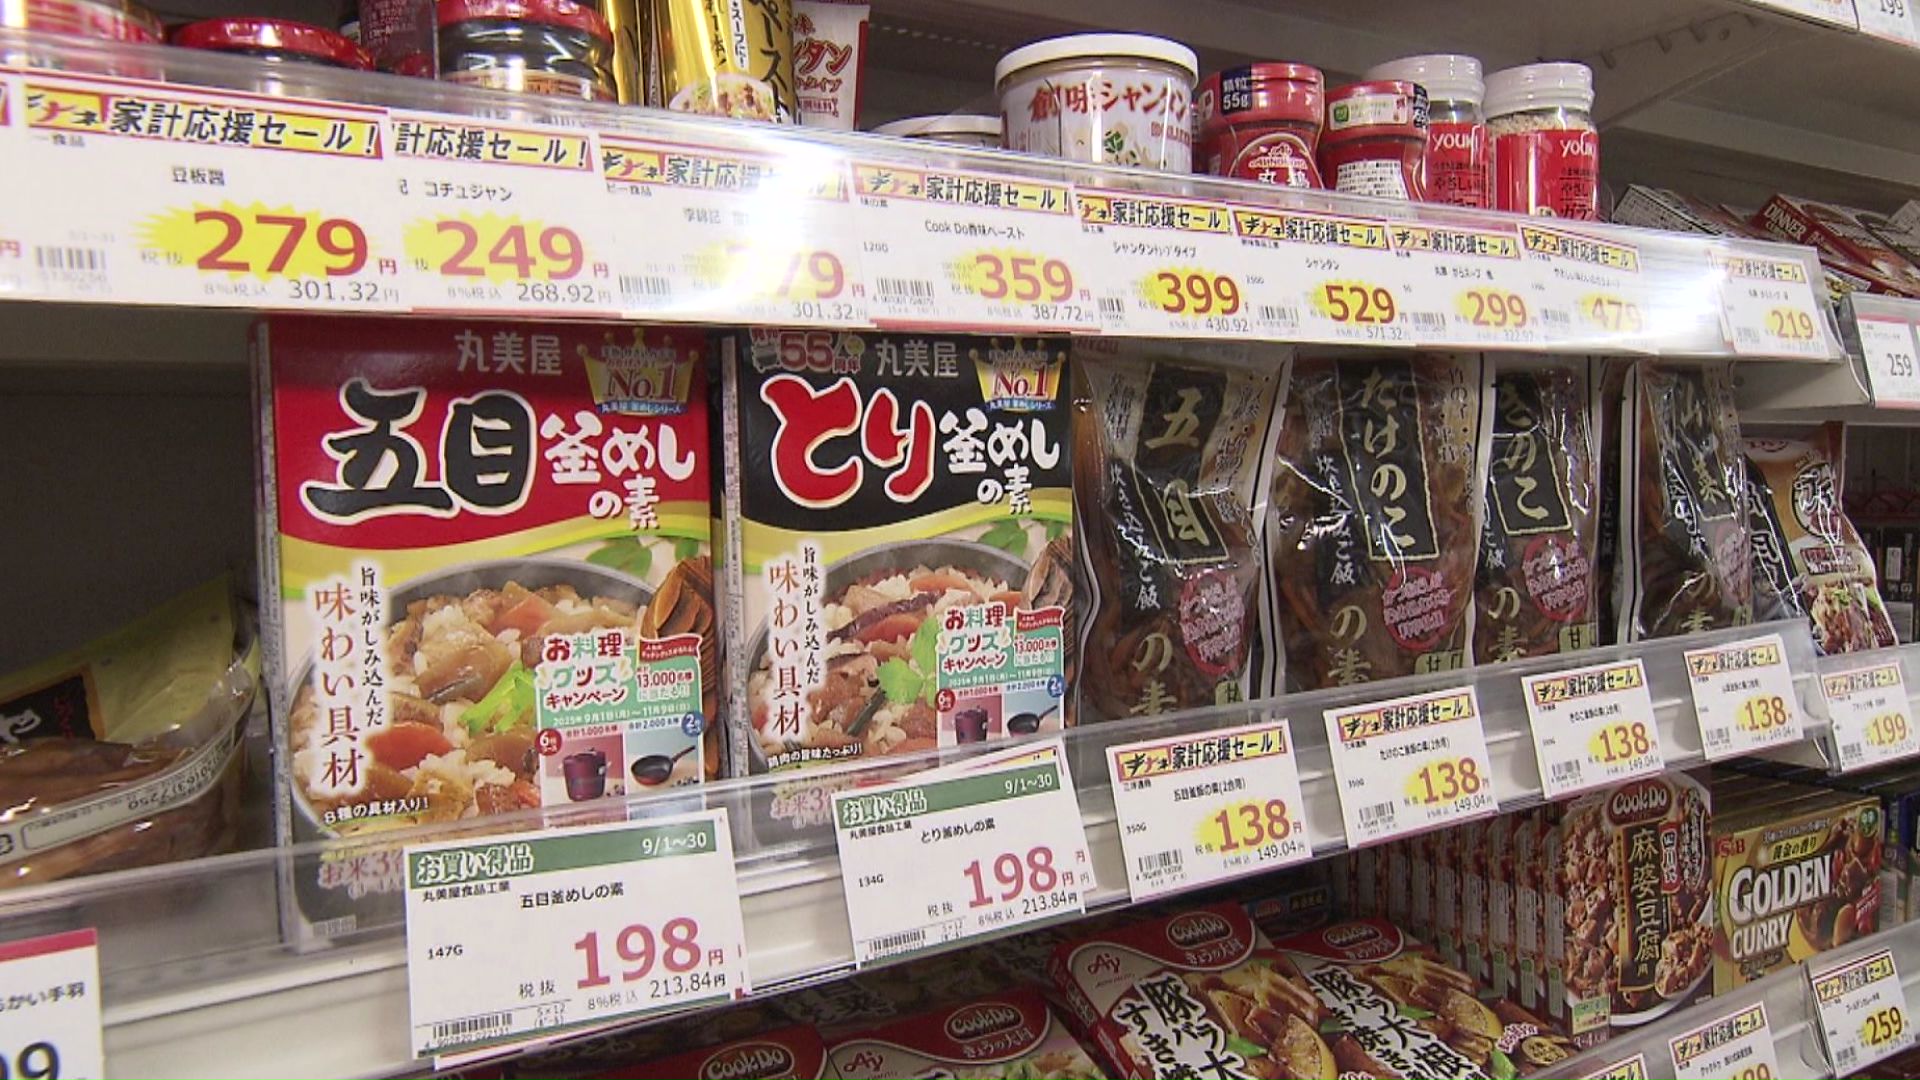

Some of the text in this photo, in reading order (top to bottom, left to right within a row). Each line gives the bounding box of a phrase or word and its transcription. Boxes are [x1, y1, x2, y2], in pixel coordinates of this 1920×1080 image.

[193, 209, 369, 278] 279
[1763, 201, 1807, 241] DINNER
[435, 219, 585, 280] 249
[976, 253, 1074, 303] 359
[1156, 271, 1240, 316] 399
[1324, 284, 1396, 325] 529
[1467, 290, 1527, 329] 299
[1771, 309, 1814, 340] 219
[454, 329, 563, 376] 丸美屋
[875, 337, 960, 379] 丸美屋
[992, 362, 1048, 398] No.1
[300, 377, 538, 524] 五目
[540, 410, 697, 485] 釜めし
[760, 374, 936, 509] とり
[939, 407, 1060, 475] 釜めし
[588, 474, 661, 531] の素
[976, 463, 1034, 516] の素
[769, 559, 805, 737] 味わい具材
[314, 581, 365, 790] 味わい具材
[546, 687, 625, 710] キャンペーン
[1383, 695, 1473, 732] 家計応援セール！
[1743, 695, 1788, 732] 138
[1871, 711, 1909, 746] 199
[1172, 730, 1284, 770] 家計応援セール！
[1598, 721, 1651, 764] 138
[1418, 756, 1481, 805] 138
[842, 787, 928, 826] お買い得品
[1214, 798, 1292, 853] 138
[920, 817, 996, 844] とり釜めしの素
[417, 842, 535, 886] お買い得品
[858, 874, 885, 889] 134G
[963, 846, 1058, 909] 198
[1062, 870, 1075, 886] 円
[519, 881, 625, 909] 五目釜めしの素
[1628, 827, 1662, 963] 麻婆豆腐
[1728, 853, 1832, 925] GOLDEN
[427, 944, 464, 960] 147G
[574, 917, 703, 990] 198
[707, 949, 725, 967] 円
[1732, 910, 1794, 960] CURRY
[1865, 1006, 1903, 1046] 259
